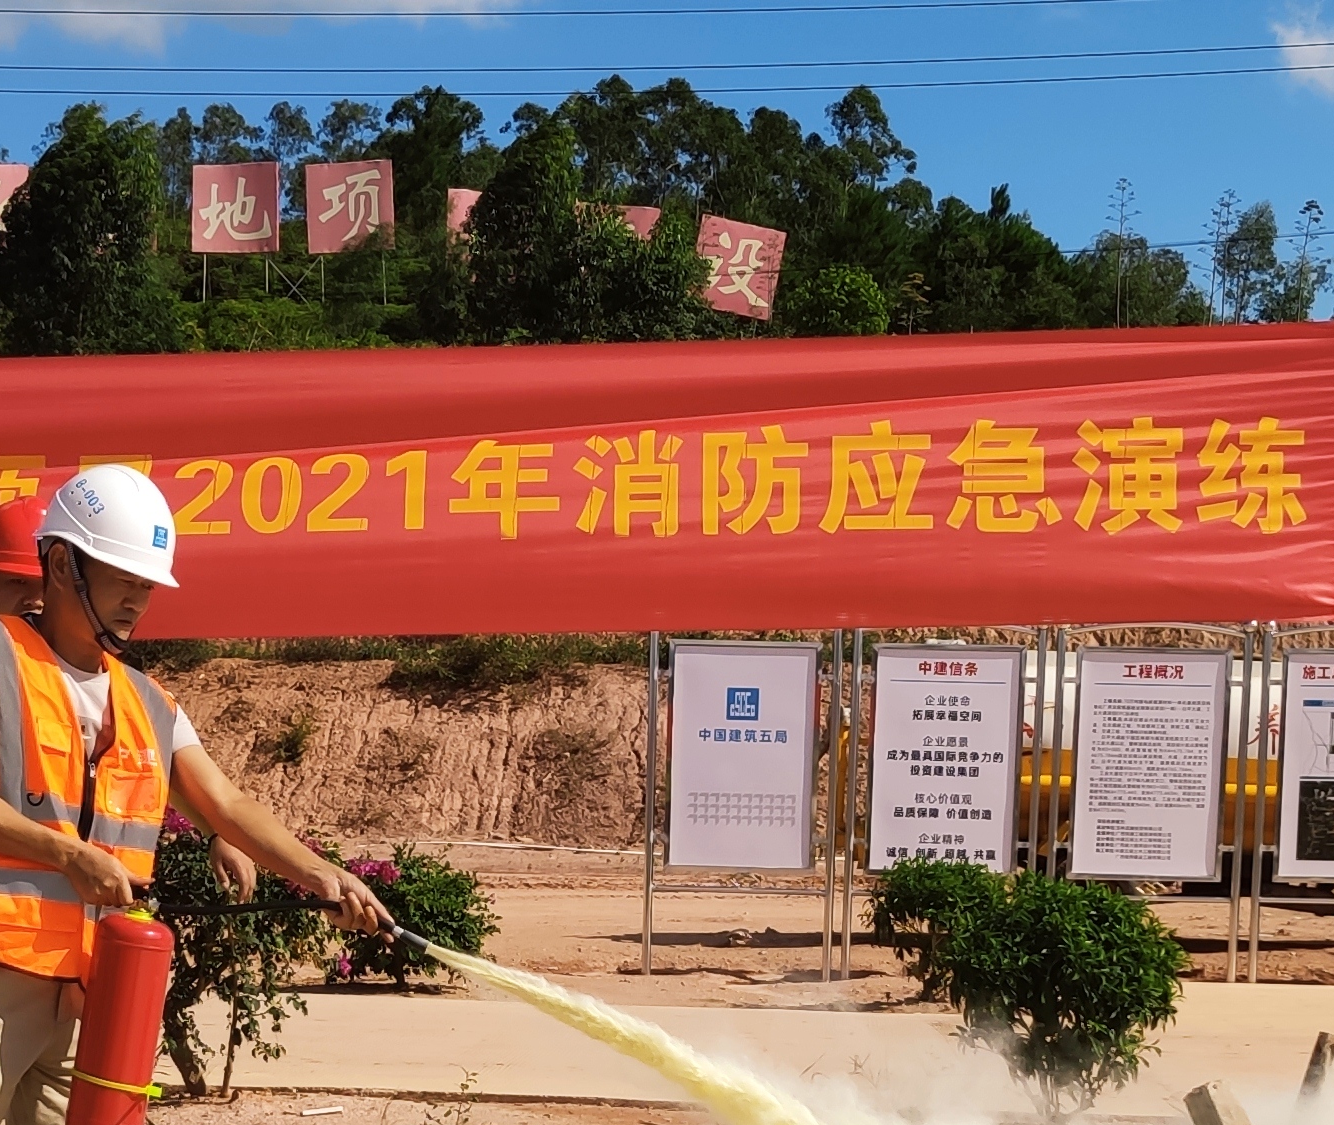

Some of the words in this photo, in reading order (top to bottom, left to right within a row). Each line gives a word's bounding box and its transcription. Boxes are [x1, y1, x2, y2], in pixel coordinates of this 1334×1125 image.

[75, 478, 105, 515] B-003
[918, 661, 979, 676] 中建信条
[1122, 664, 1185, 680] 工程概况
[924, 695, 971, 706] 企业使命
[912, 709, 982, 722] 拓展幸福空间
[698, 728, 788, 743] 中国建筑五局
[922, 736, 969, 748] 企业愿景
[887, 750, 1004, 763] 成为最具国际竞争力的
[910, 765, 980, 777] 投资建设集团
[914, 793, 973, 805] 核心价值观
[893, 807, 939, 819] 品质保障
[946, 808, 992, 820] 价值创造
[918, 833, 965, 844] 企业精神
[886, 847, 909, 858] 诚信
[915, 848, 938, 859] 创新
[944, 849, 968, 860] 超越
[973, 849, 996, 860] 共赢
